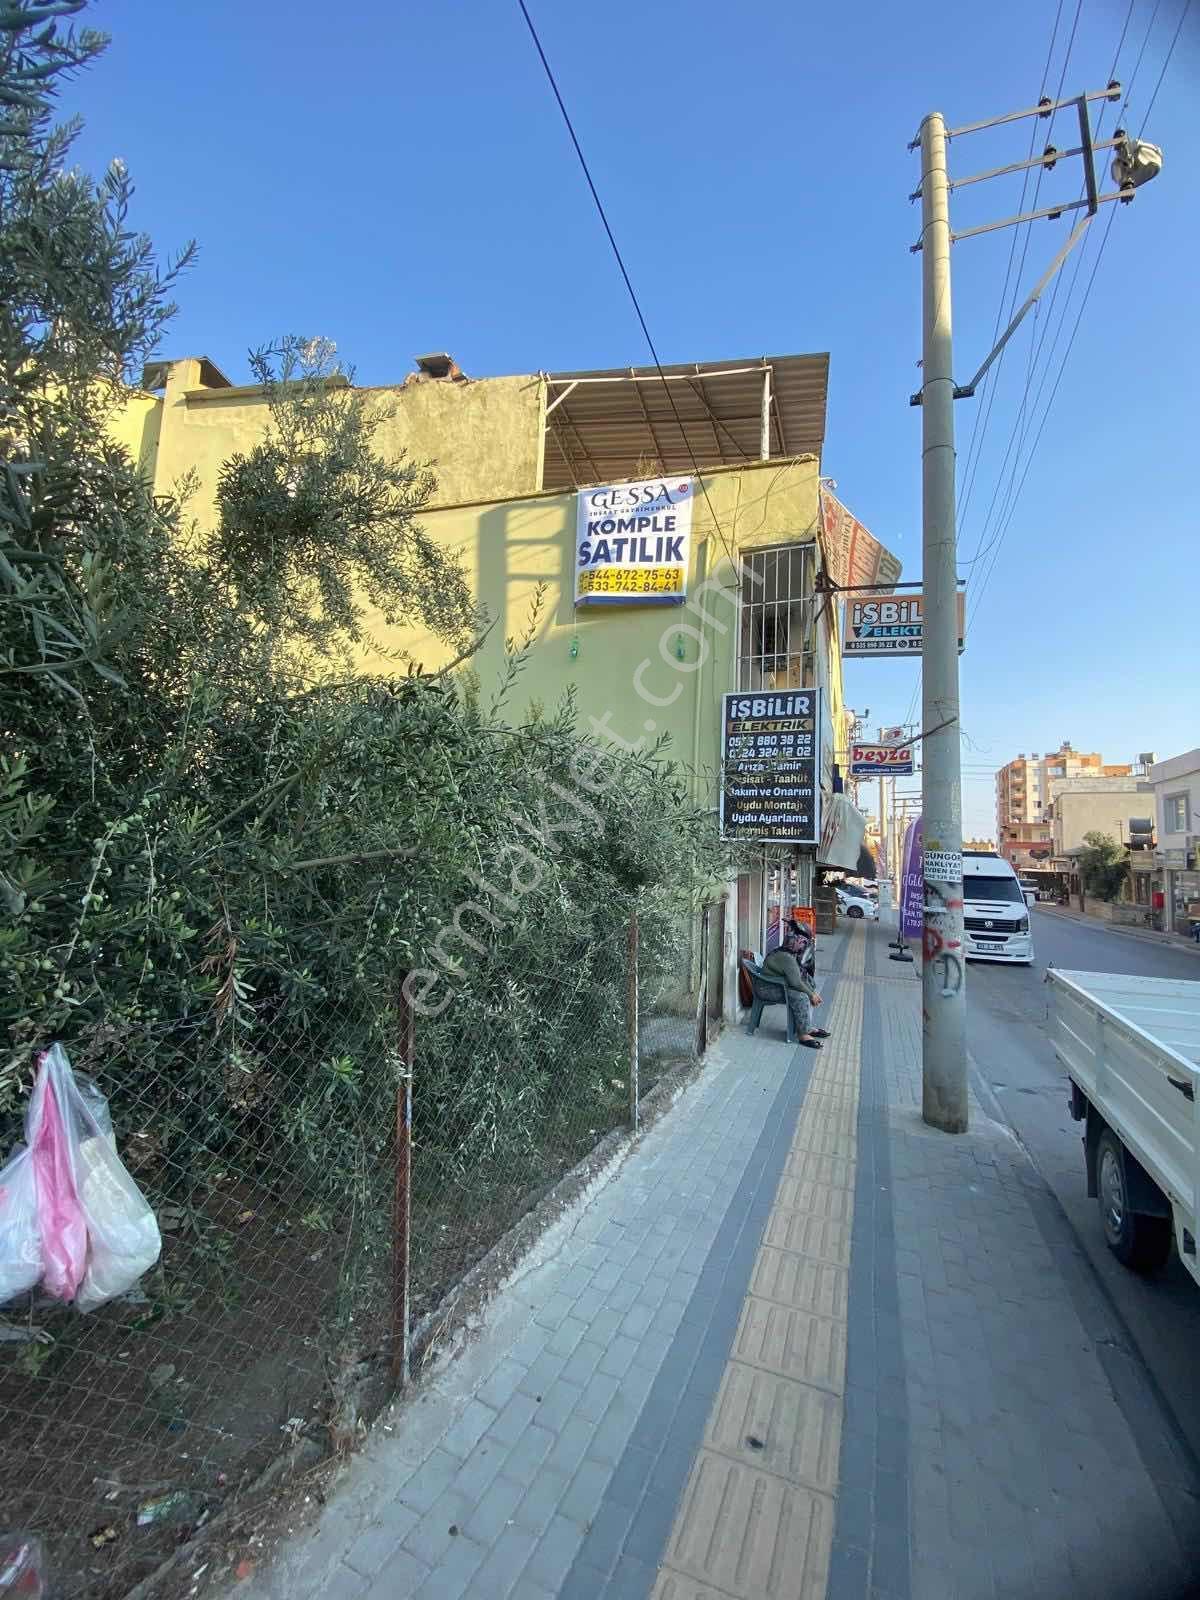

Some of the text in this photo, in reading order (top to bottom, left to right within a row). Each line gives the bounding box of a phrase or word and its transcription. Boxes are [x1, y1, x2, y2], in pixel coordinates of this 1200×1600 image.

[591, 484, 676, 509] GESSA
[587, 515, 676, 537] KOMPLE
[578, 536, 685, 566] SATILIK
[873, 626, 923, 637] ELEKT
[797, 734, 811, 744] 22
[796, 746, 811, 756] 02
[853, 747, 911, 764] beyza
[759, 788, 771, 796] ve
[773, 786, 812, 796] Onarım
[736, 801, 762, 812] Uydu
[731, 813, 809, 825] Uydu Ayarlama
